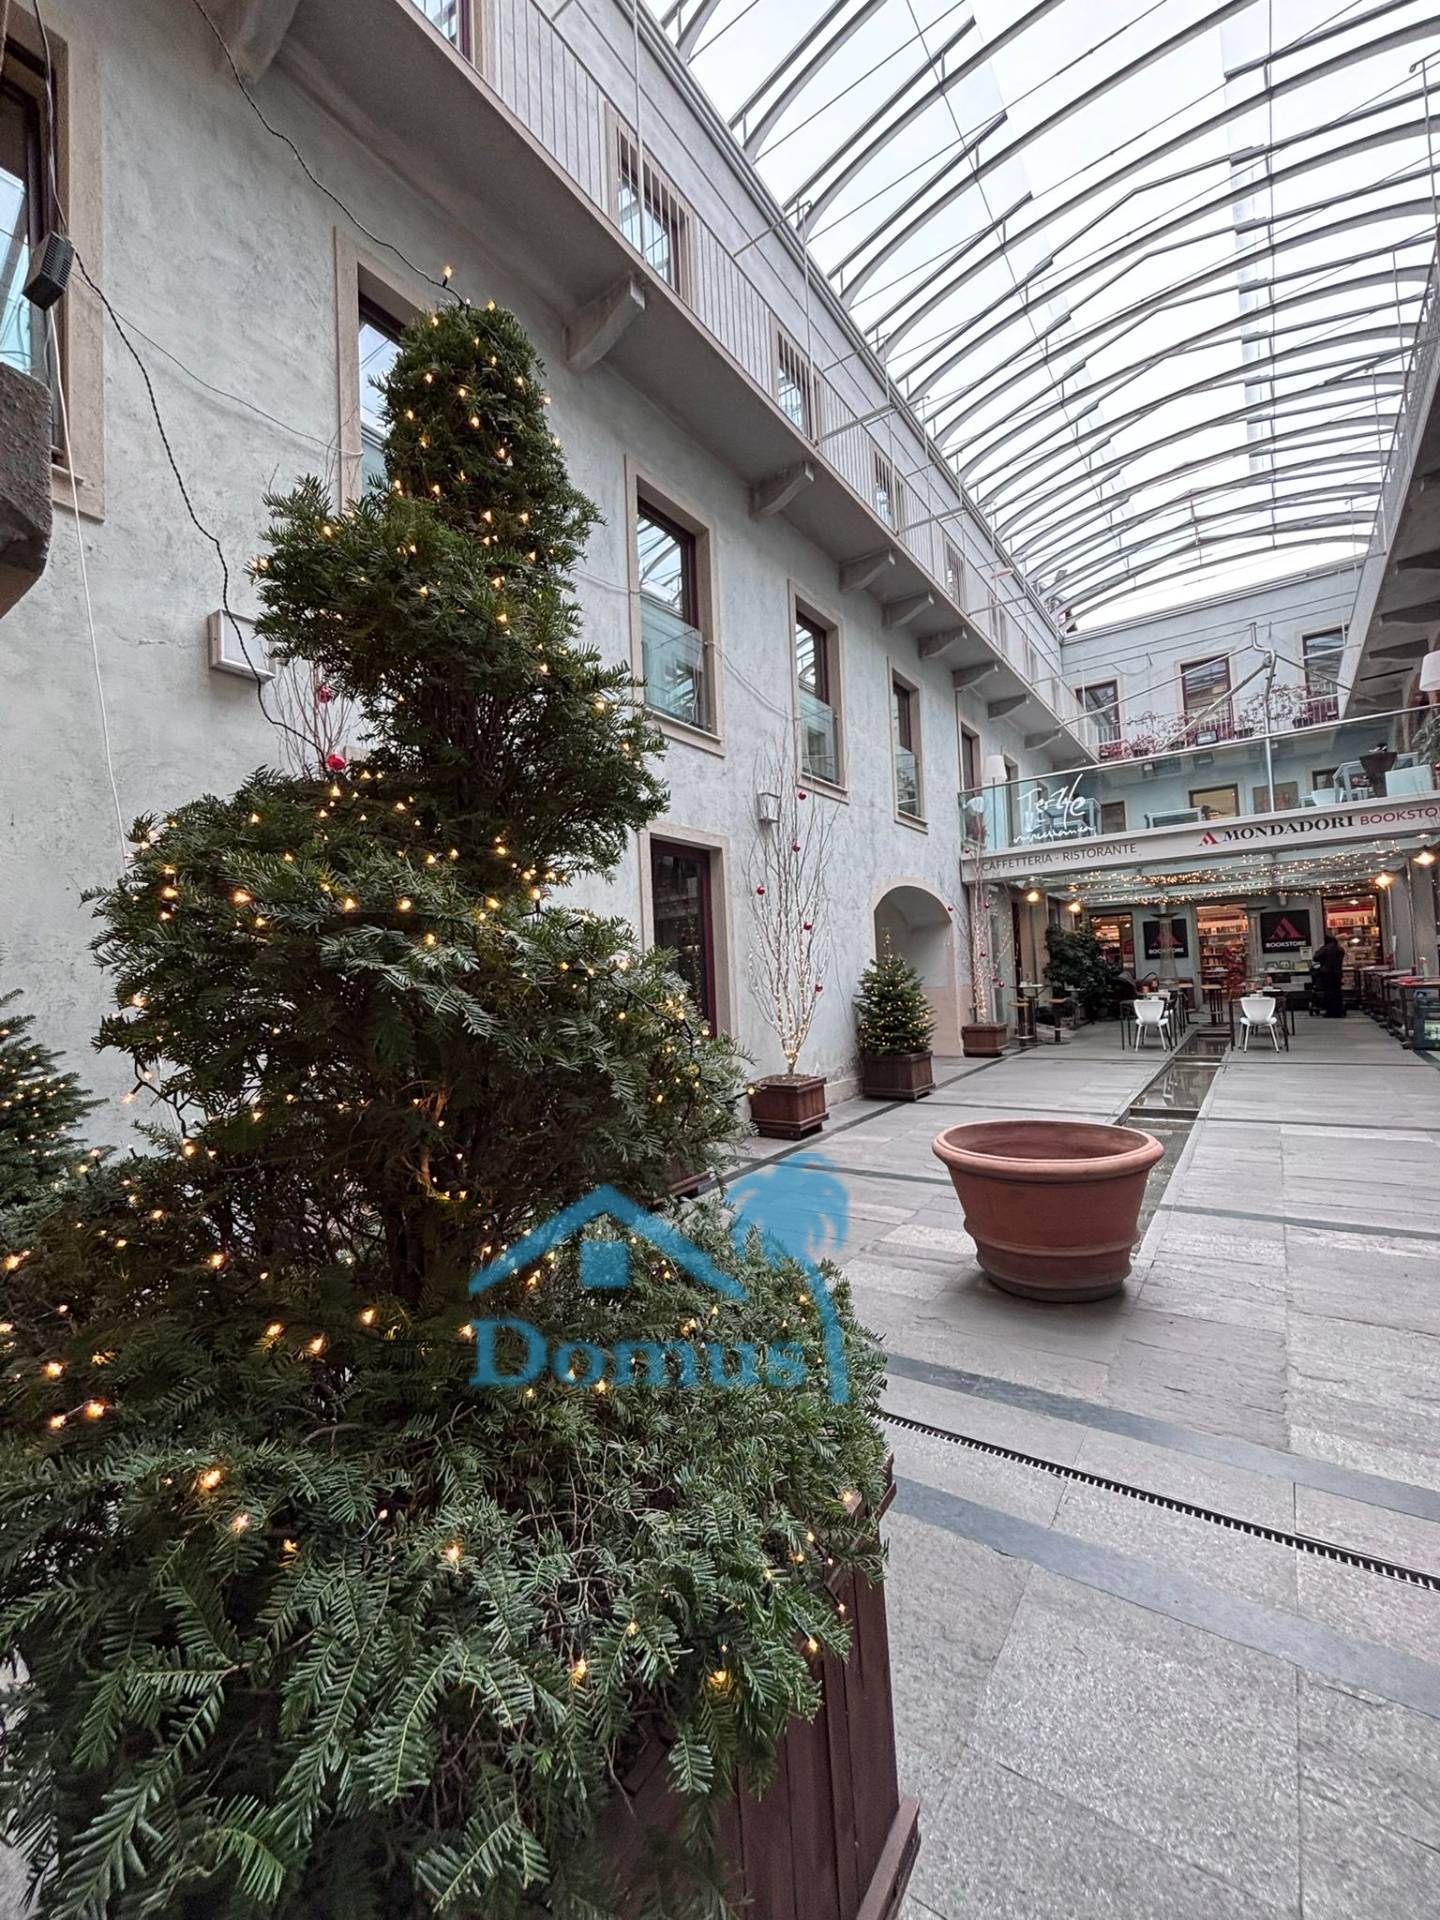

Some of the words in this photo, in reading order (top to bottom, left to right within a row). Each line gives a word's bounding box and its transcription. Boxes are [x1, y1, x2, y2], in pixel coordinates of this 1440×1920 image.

[1222, 815, 1355, 842] MONDADORI
[1360, 806, 1440, 826] BOOKSTO
[981, 853, 1053, 872] CAFFETTERIA
[1062, 843, 1137, 861] RISTORANTE
[1265, 940, 1307, 948] BOOKSTORE
